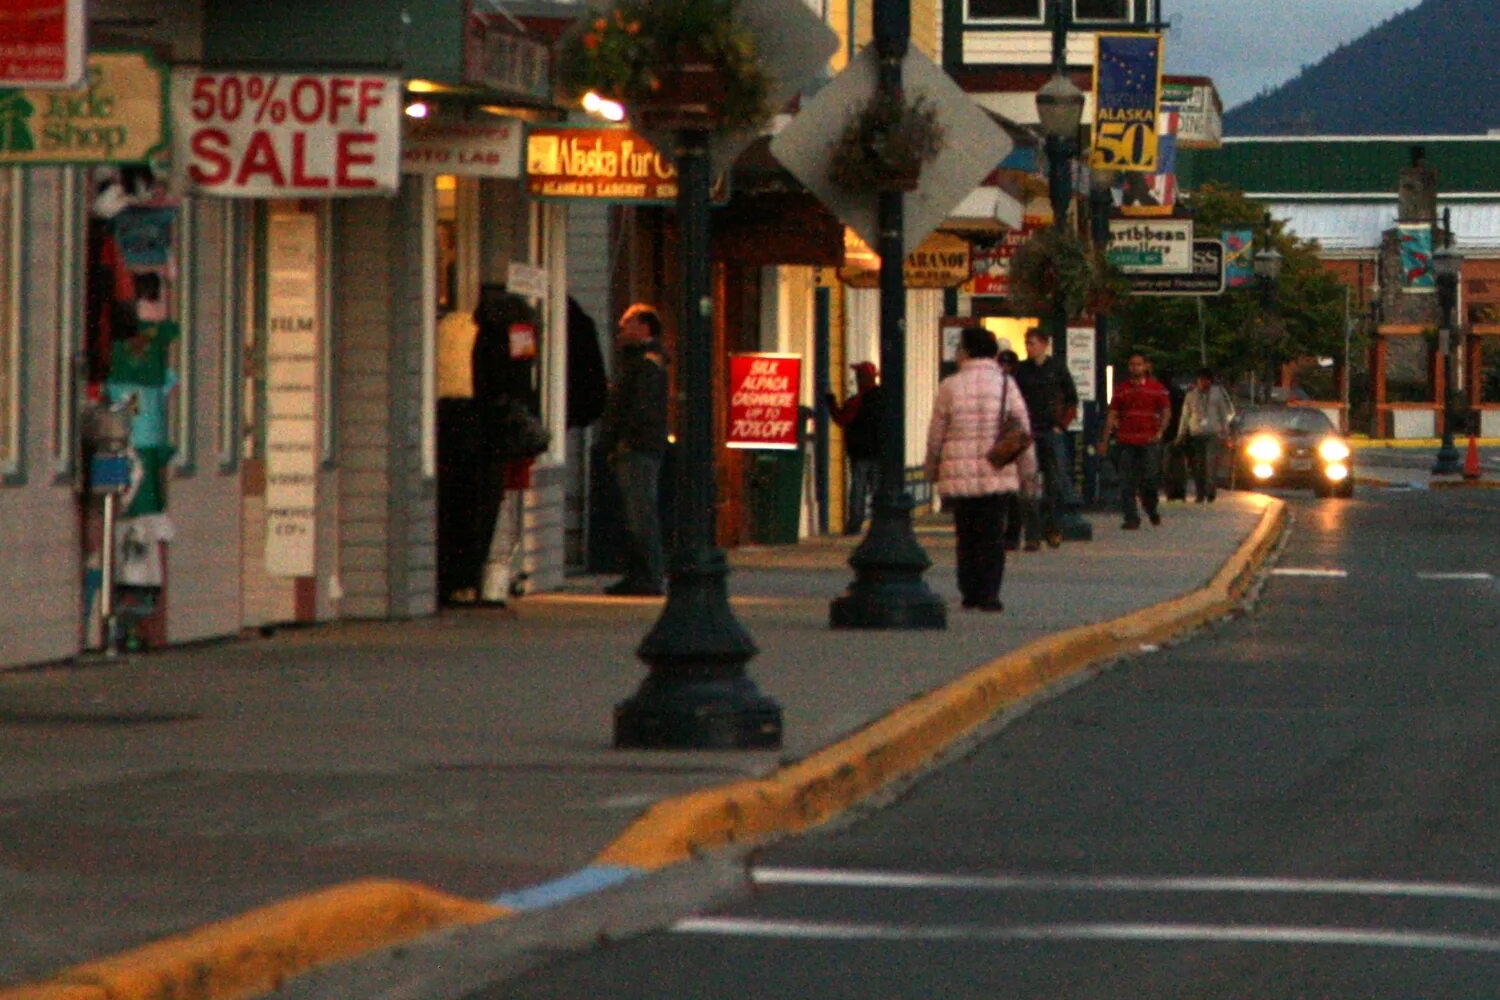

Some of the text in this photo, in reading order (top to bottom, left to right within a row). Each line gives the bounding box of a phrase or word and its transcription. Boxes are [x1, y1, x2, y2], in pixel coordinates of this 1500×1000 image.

[1099, 107, 1154, 119] ALASKA
[43, 120, 127, 158] Shop
[1096, 121, 1155, 164] 50
[187, 127, 378, 189] SALE
[557, 137, 618, 176] Alaska
[620, 140, 653, 176] Fur
[907, 253, 965, 268] ARANOF
[271, 316, 314, 332] FILM
[749, 360, 779, 375] SILK
